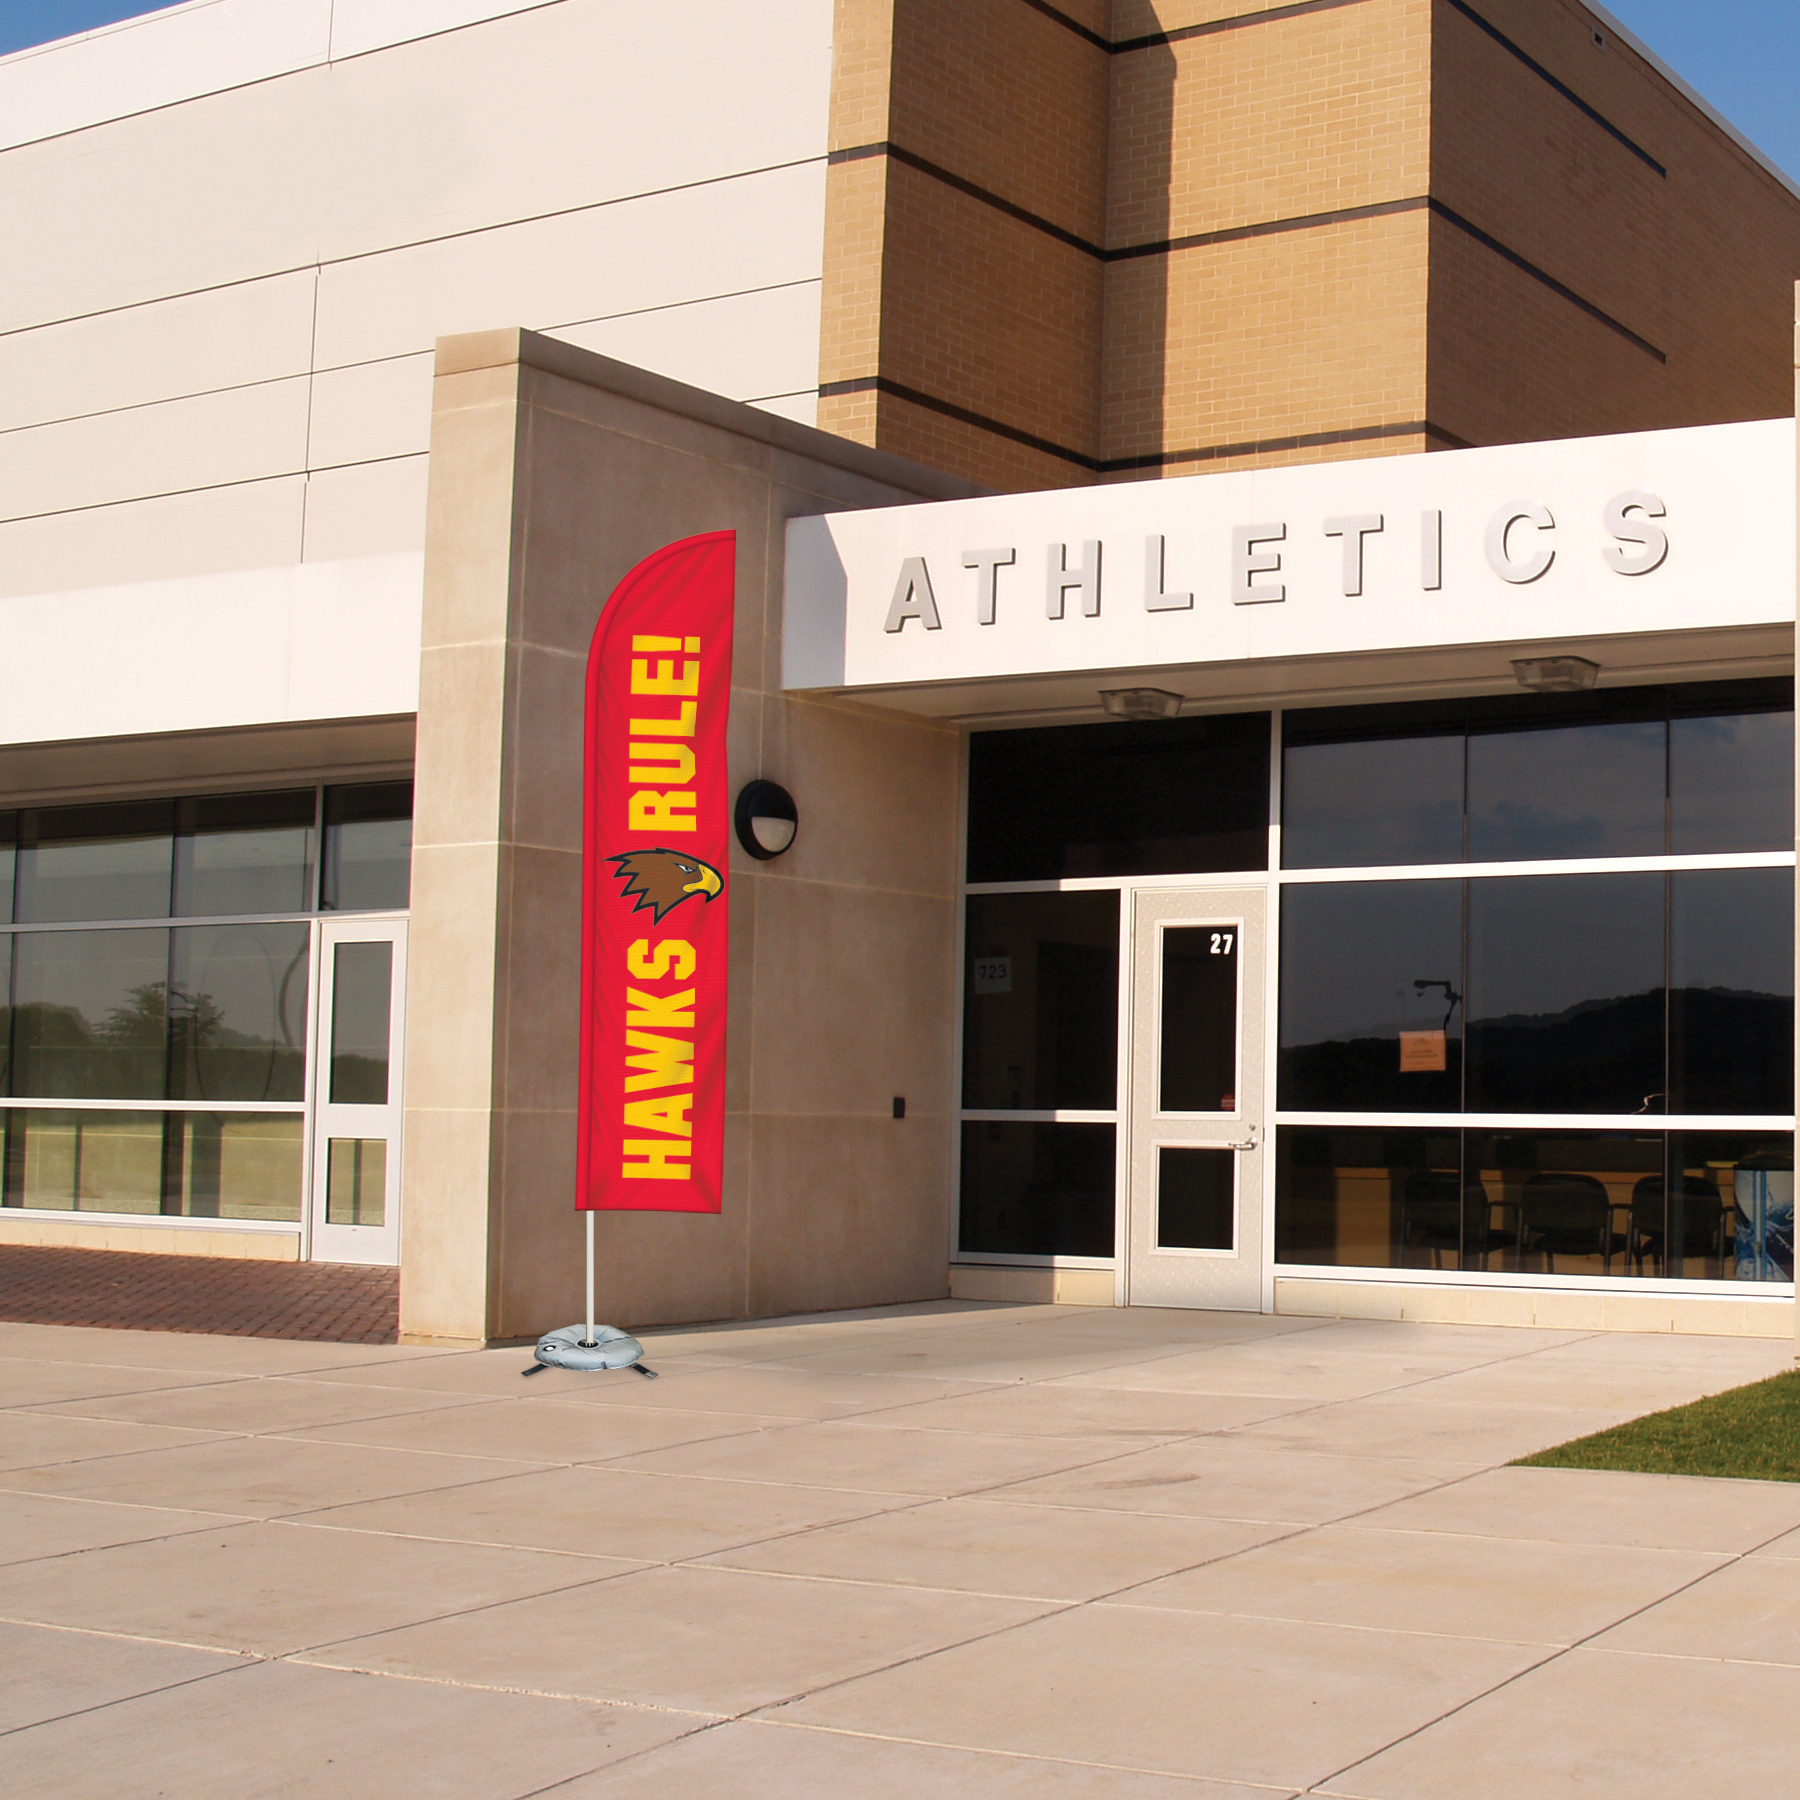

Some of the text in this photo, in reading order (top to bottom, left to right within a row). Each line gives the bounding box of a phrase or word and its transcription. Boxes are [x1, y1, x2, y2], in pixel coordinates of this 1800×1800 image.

[884, 490, 1668, 633] ATHLETICS
[622, 634, 701, 1180] HAWKS RULE!
[1209, 933, 1234, 955] 27
[979, 963, 1007, 980] 723
